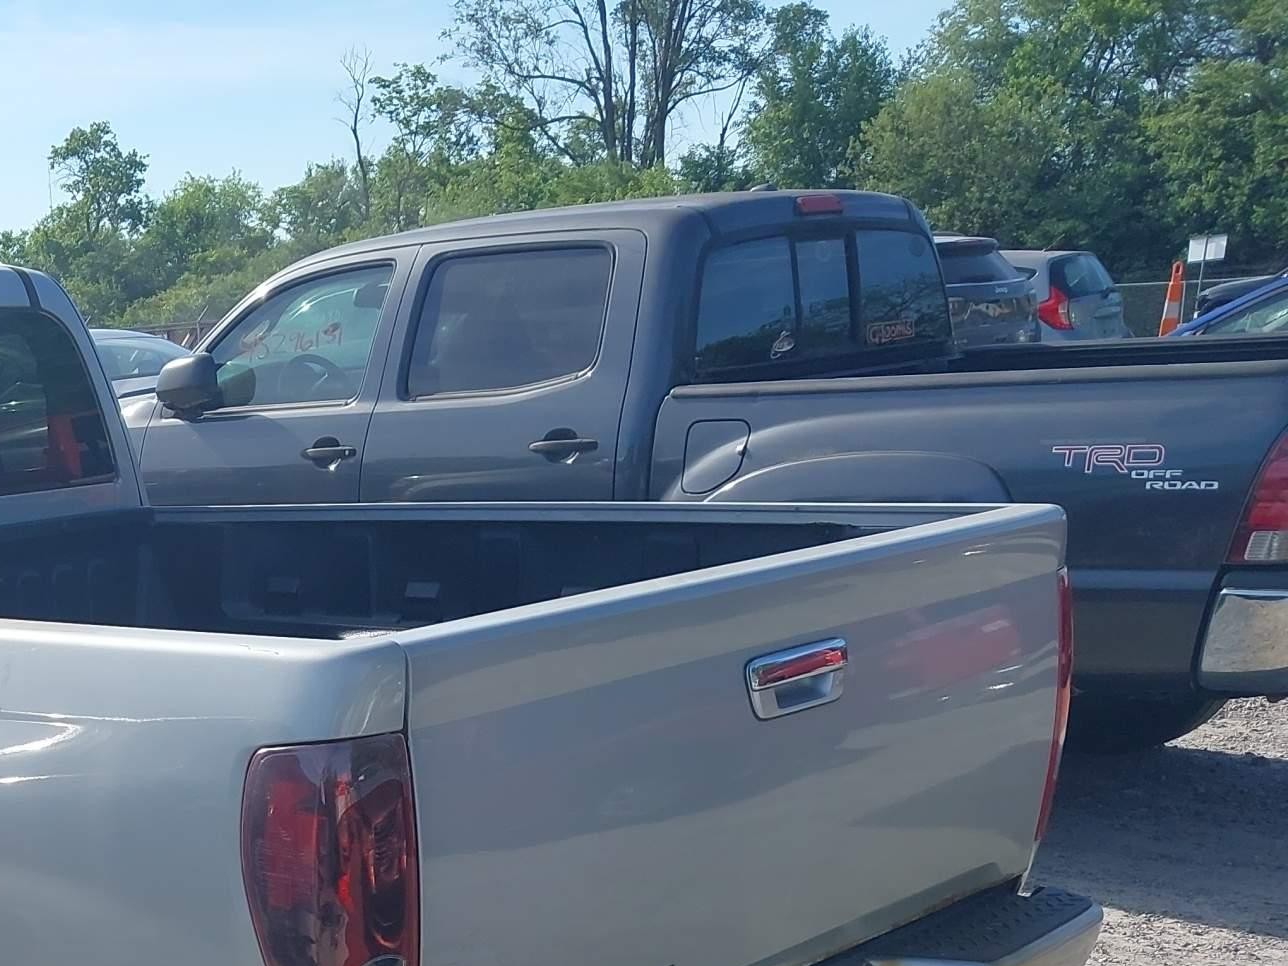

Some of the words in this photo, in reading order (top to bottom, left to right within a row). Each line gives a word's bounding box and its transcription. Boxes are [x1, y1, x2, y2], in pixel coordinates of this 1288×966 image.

[1052, 444, 1166, 474] TRD
[1130, 469, 1184, 479] OFF
[1144, 480, 1220, 491] ROAD
